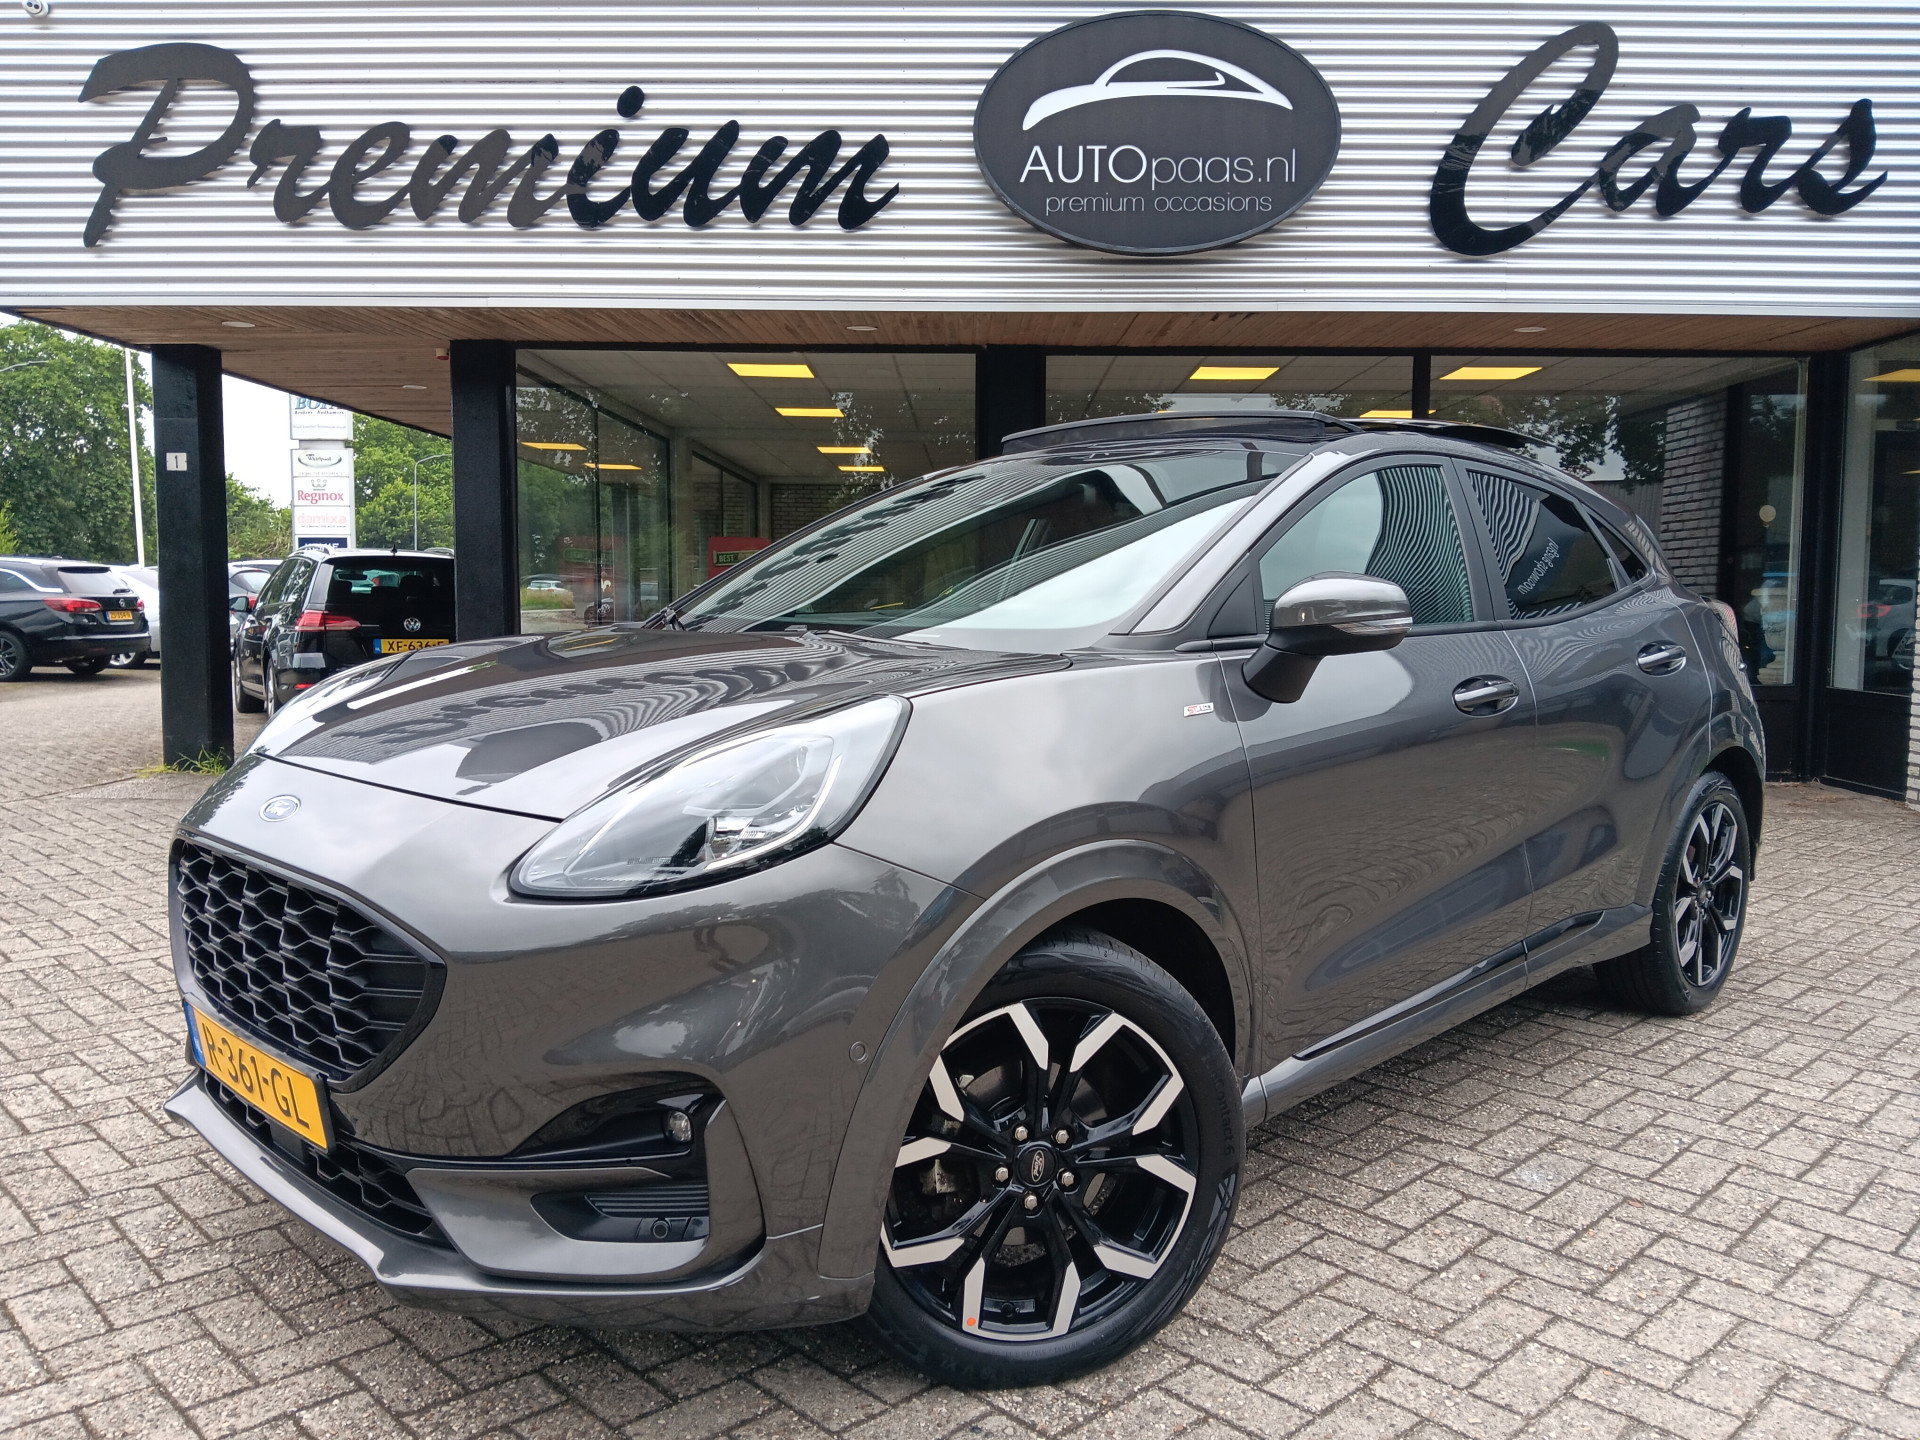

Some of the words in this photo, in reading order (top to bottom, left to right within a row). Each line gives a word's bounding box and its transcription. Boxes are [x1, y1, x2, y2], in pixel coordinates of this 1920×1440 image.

[78, 43, 899, 247] Premium
[1430, 21, 1888, 256] Cars
[1019, 144, 1296, 190] AUTOpaas.nl
[1046, 192, 1145, 216] premium
[1154, 191, 1272, 212] occasions
[297, 490, 344, 504] Reginox
[202, 1022, 311, 1129] R-361-GL
